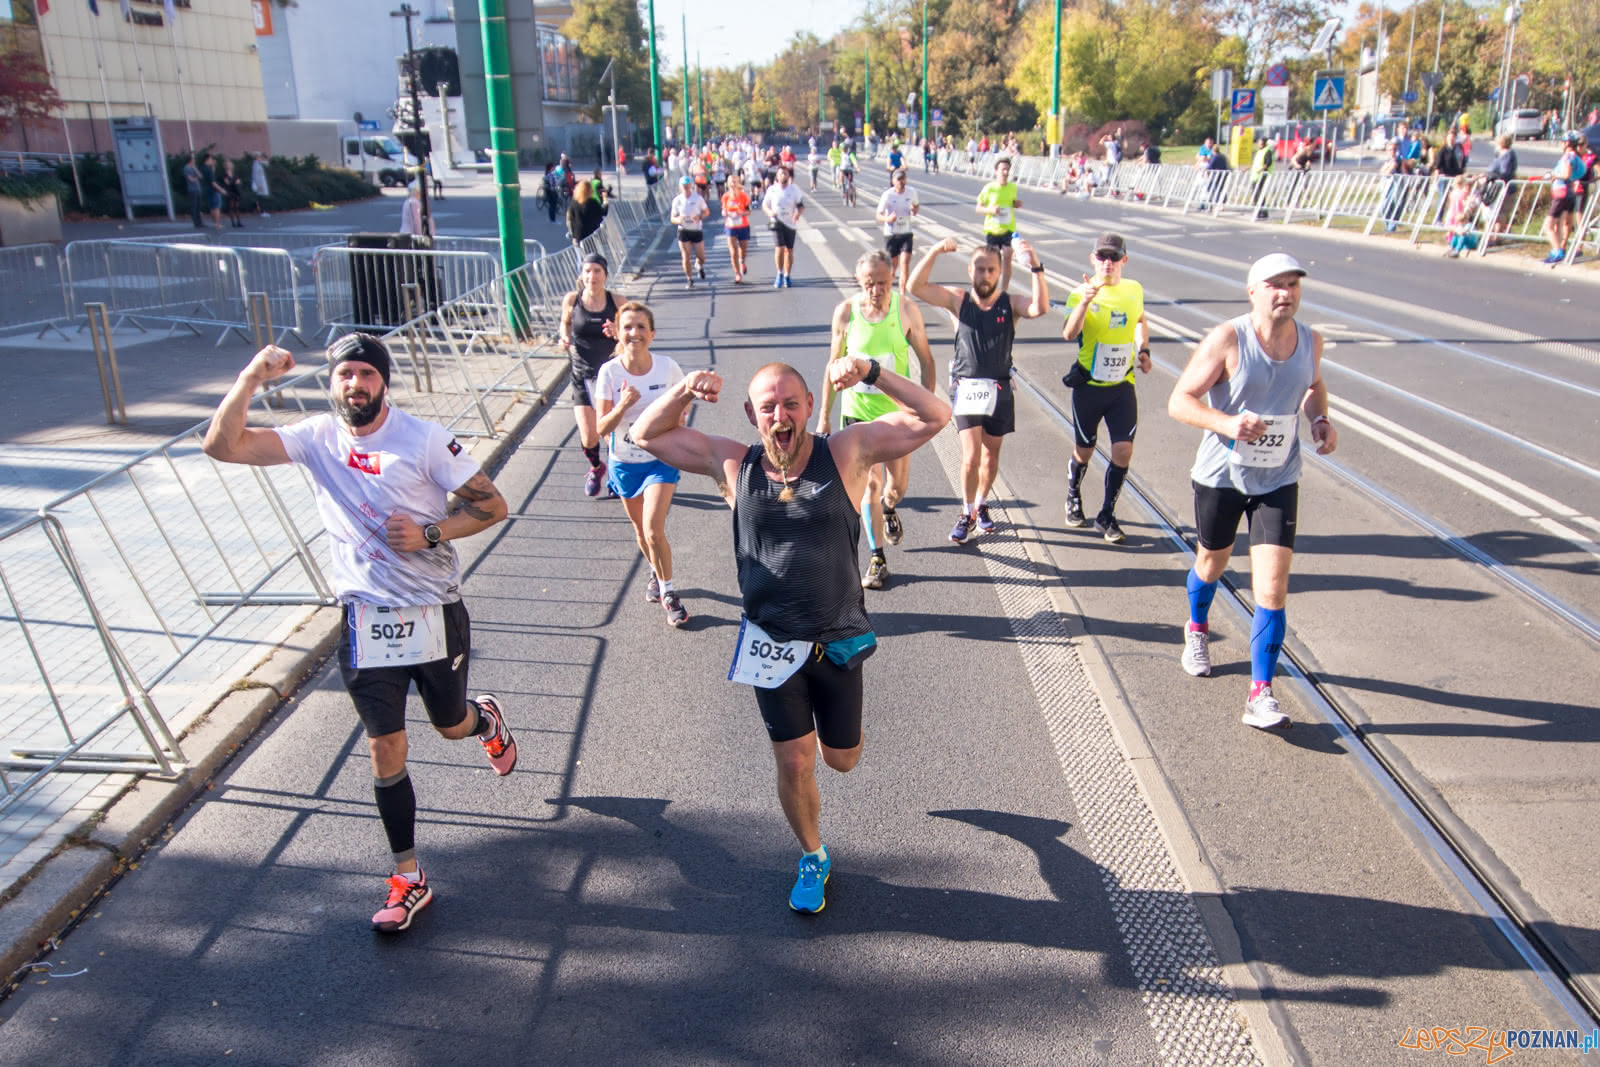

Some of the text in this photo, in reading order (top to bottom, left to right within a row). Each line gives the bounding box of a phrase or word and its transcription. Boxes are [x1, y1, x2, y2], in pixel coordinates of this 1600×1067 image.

[1103, 356, 1127, 367] 3328
[965, 391, 990, 401] 4198
[370, 620, 415, 641] 5027
[749, 639, 796, 665] 5034
[761, 662, 773, 671] Igor
